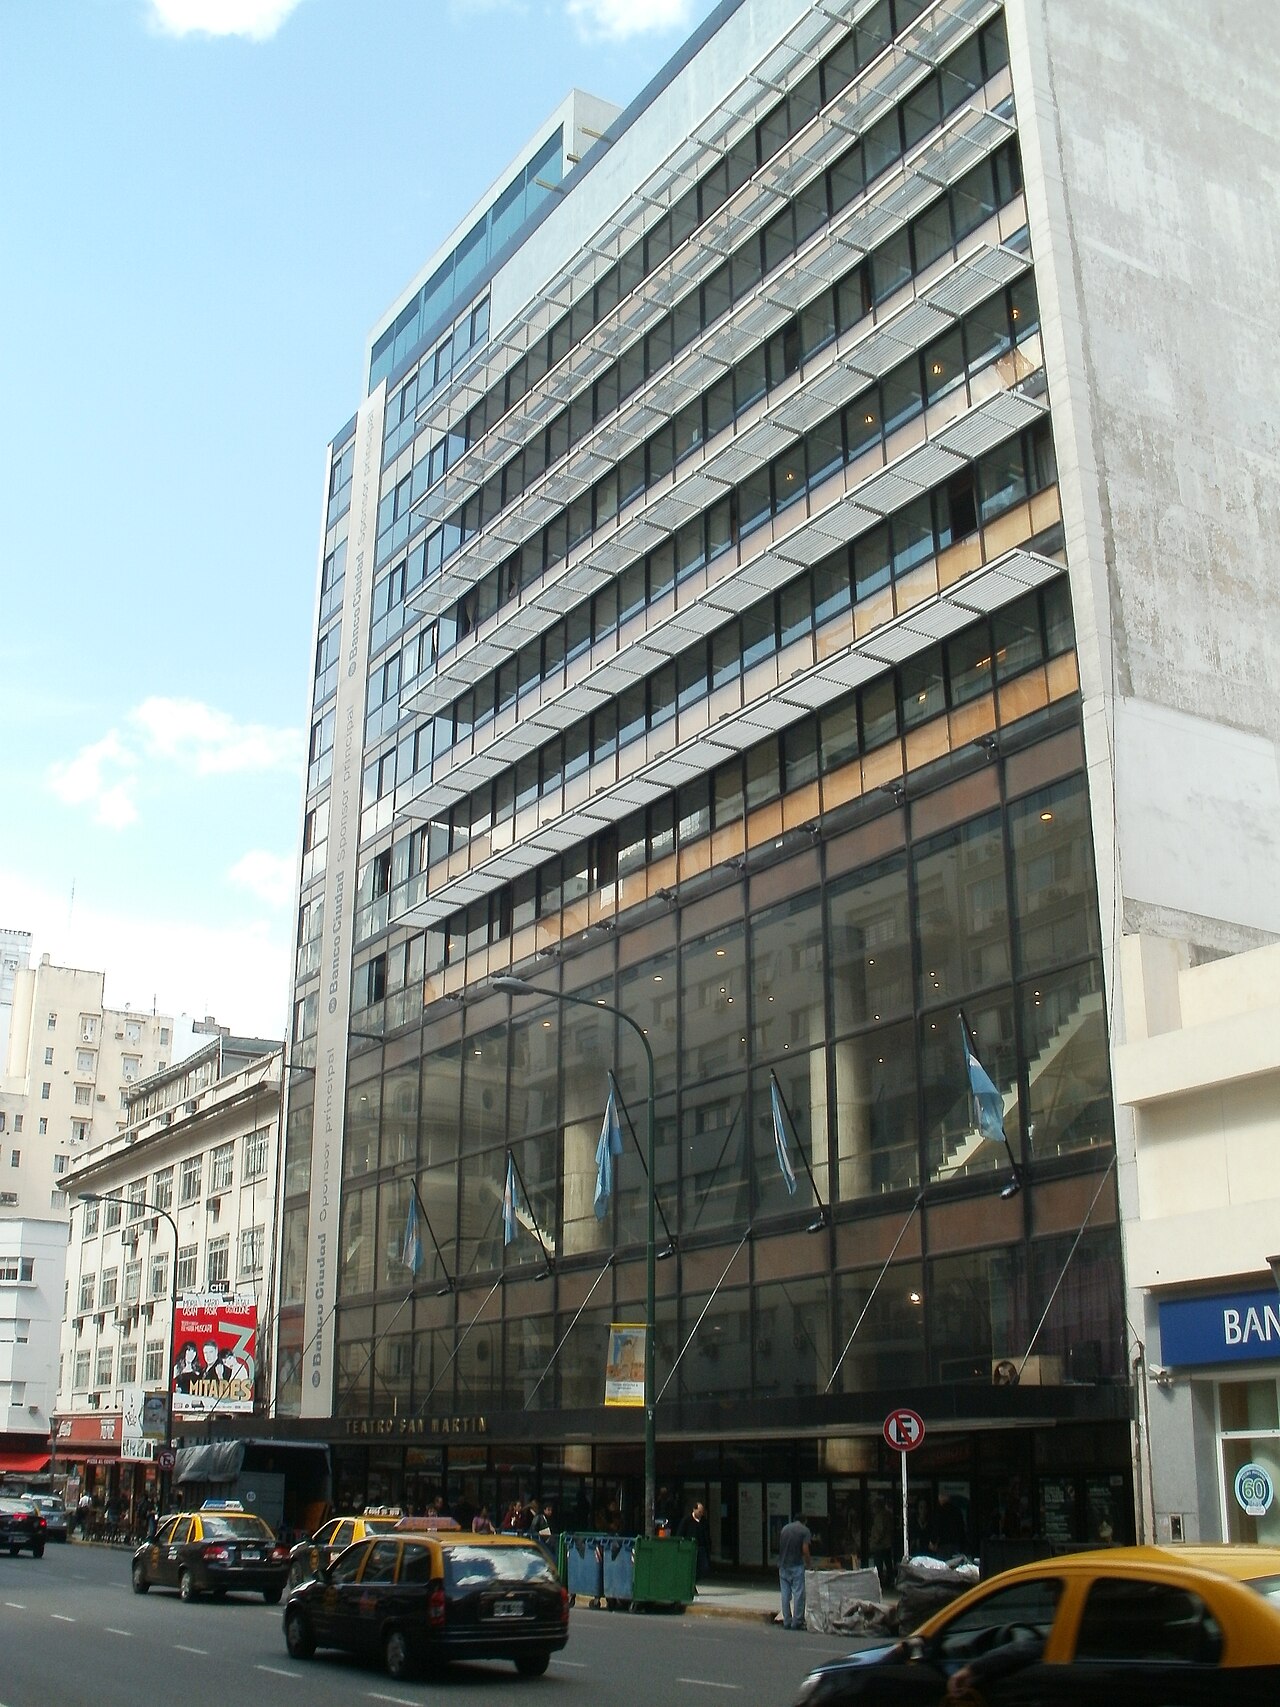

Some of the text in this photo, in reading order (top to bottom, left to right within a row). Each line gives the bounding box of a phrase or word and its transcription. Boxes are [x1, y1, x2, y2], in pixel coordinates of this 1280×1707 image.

[353, 551, 364, 608] Ciudad
[349, 608, 360, 662] Banco
[329, 704, 355, 995] Banco Ciudad Sponsor principal
[324, 1048, 335, 1133] principal
[210, 1282, 225, 1292] citi
[316, 1233, 327, 1300] Ciudad
[218, 1321, 255, 1390] 3
[313, 1304, 324, 1367] Banco
[189, 1379, 252, 1402] MITADES
[345, 1416, 487, 1434] TEATRO SAN MARTIN
[1241, 1477, 1266, 1500] 60
